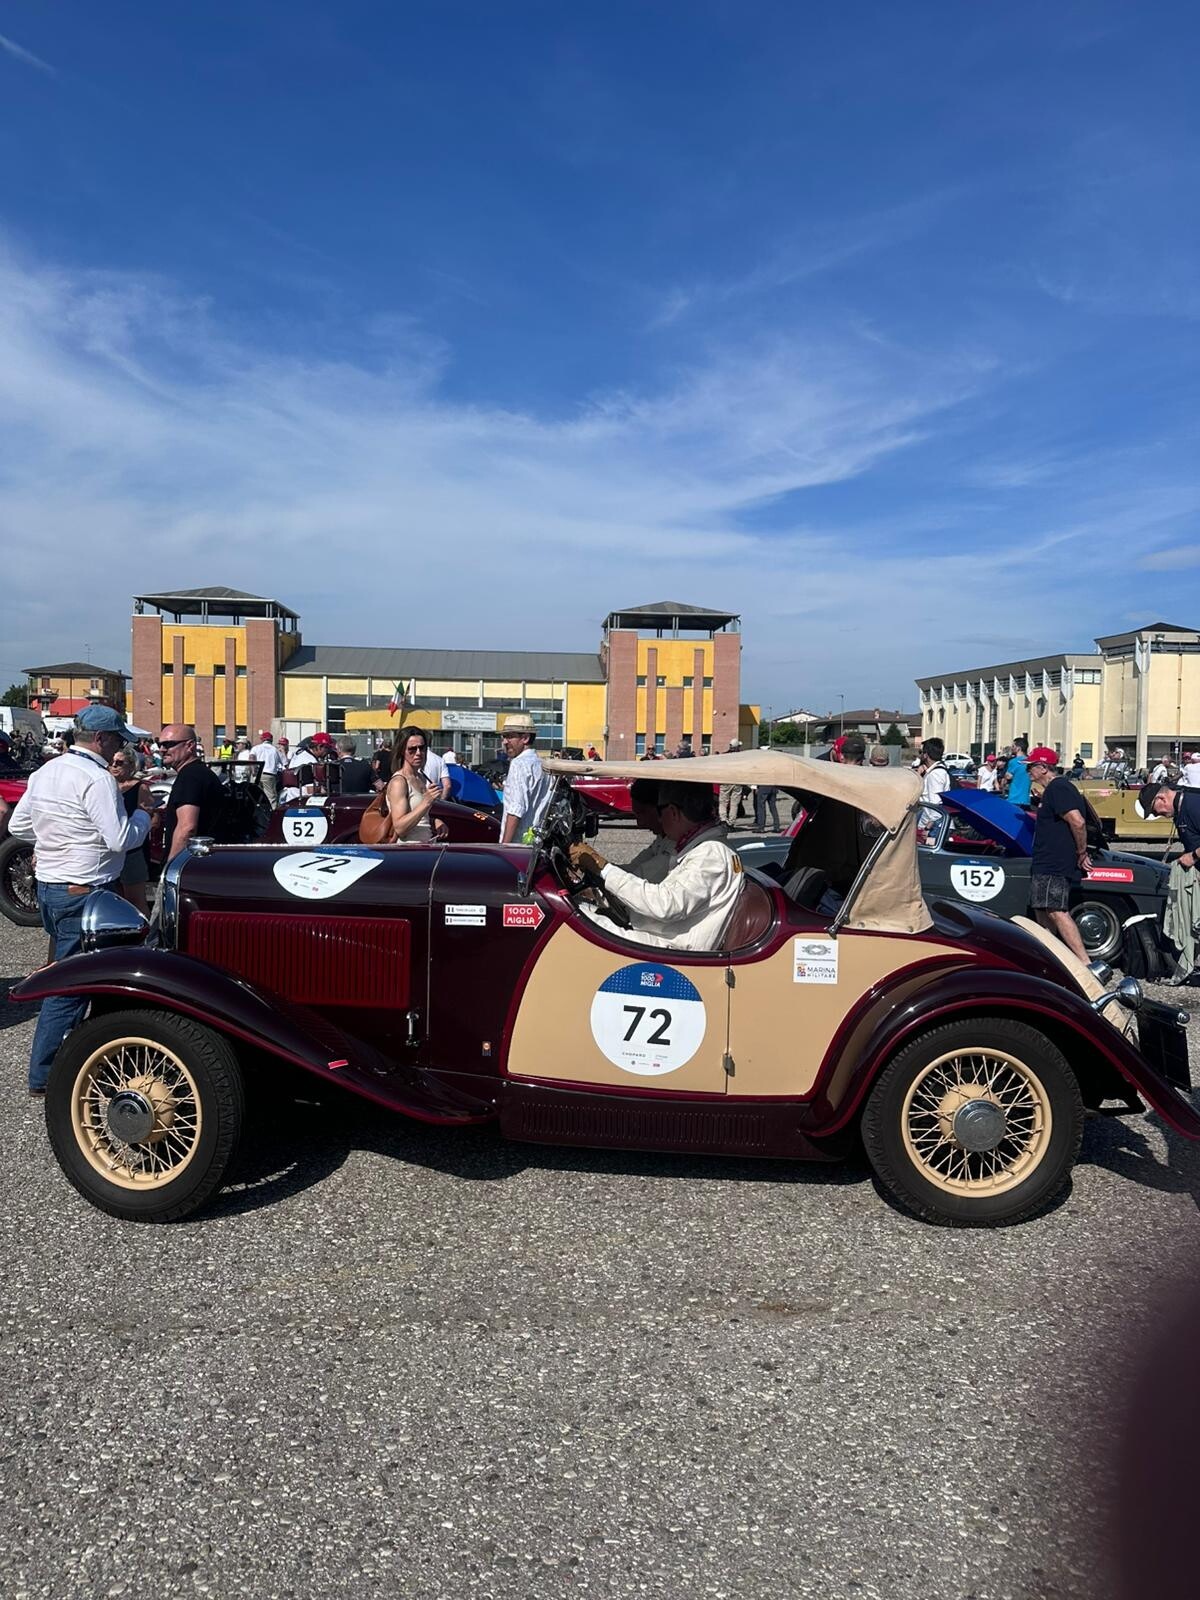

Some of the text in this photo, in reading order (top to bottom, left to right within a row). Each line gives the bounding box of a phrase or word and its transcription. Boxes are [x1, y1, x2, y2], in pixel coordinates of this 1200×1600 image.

[292, 821, 315, 838] 52
[298, 856, 351, 874] 72
[960, 869, 996, 888] 152
[1093, 871, 1127, 879] AUTOGRILL
[508, 907, 534, 915] 1000
[506, 916, 535, 925] MIGLIA
[807, 966, 836, 974] MARINA
[623, 1005, 673, 1047] 72
